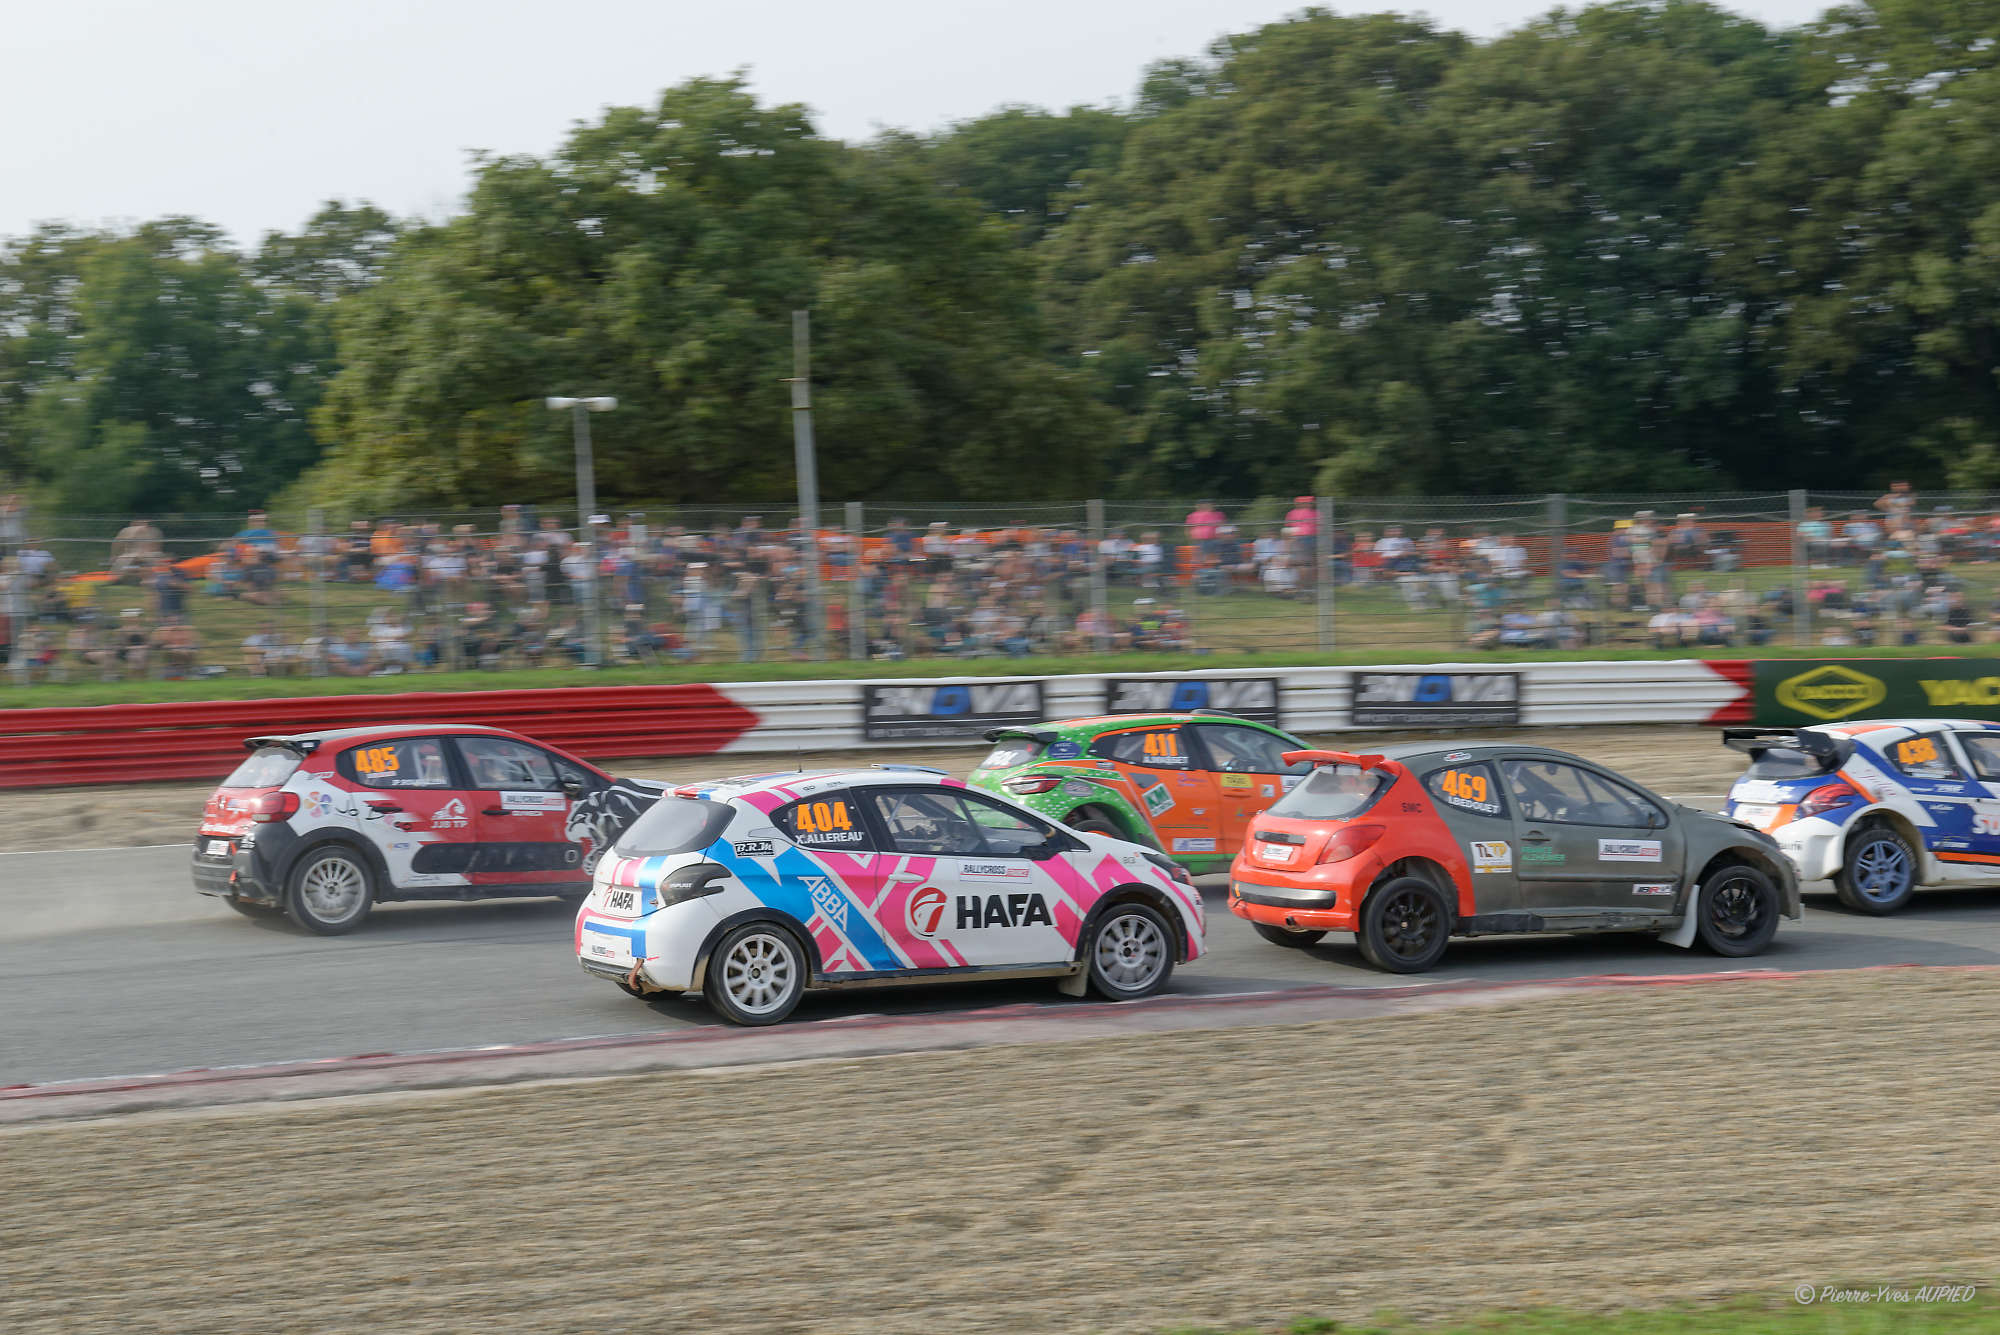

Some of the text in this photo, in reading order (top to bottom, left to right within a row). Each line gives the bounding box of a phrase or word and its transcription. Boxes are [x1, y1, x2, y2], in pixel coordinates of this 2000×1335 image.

[355, 746, 400, 773] 485
[1143, 733, 1178, 758] 411
[1441, 769, 1487, 803] 469
[796, 801, 852, 833] 404
[963, 864, 1006, 875] RALLYCROSS
[610, 890, 634, 911] HAFA
[797, 876, 848, 932] ABBA
[956, 893, 1053, 930] HAFA
